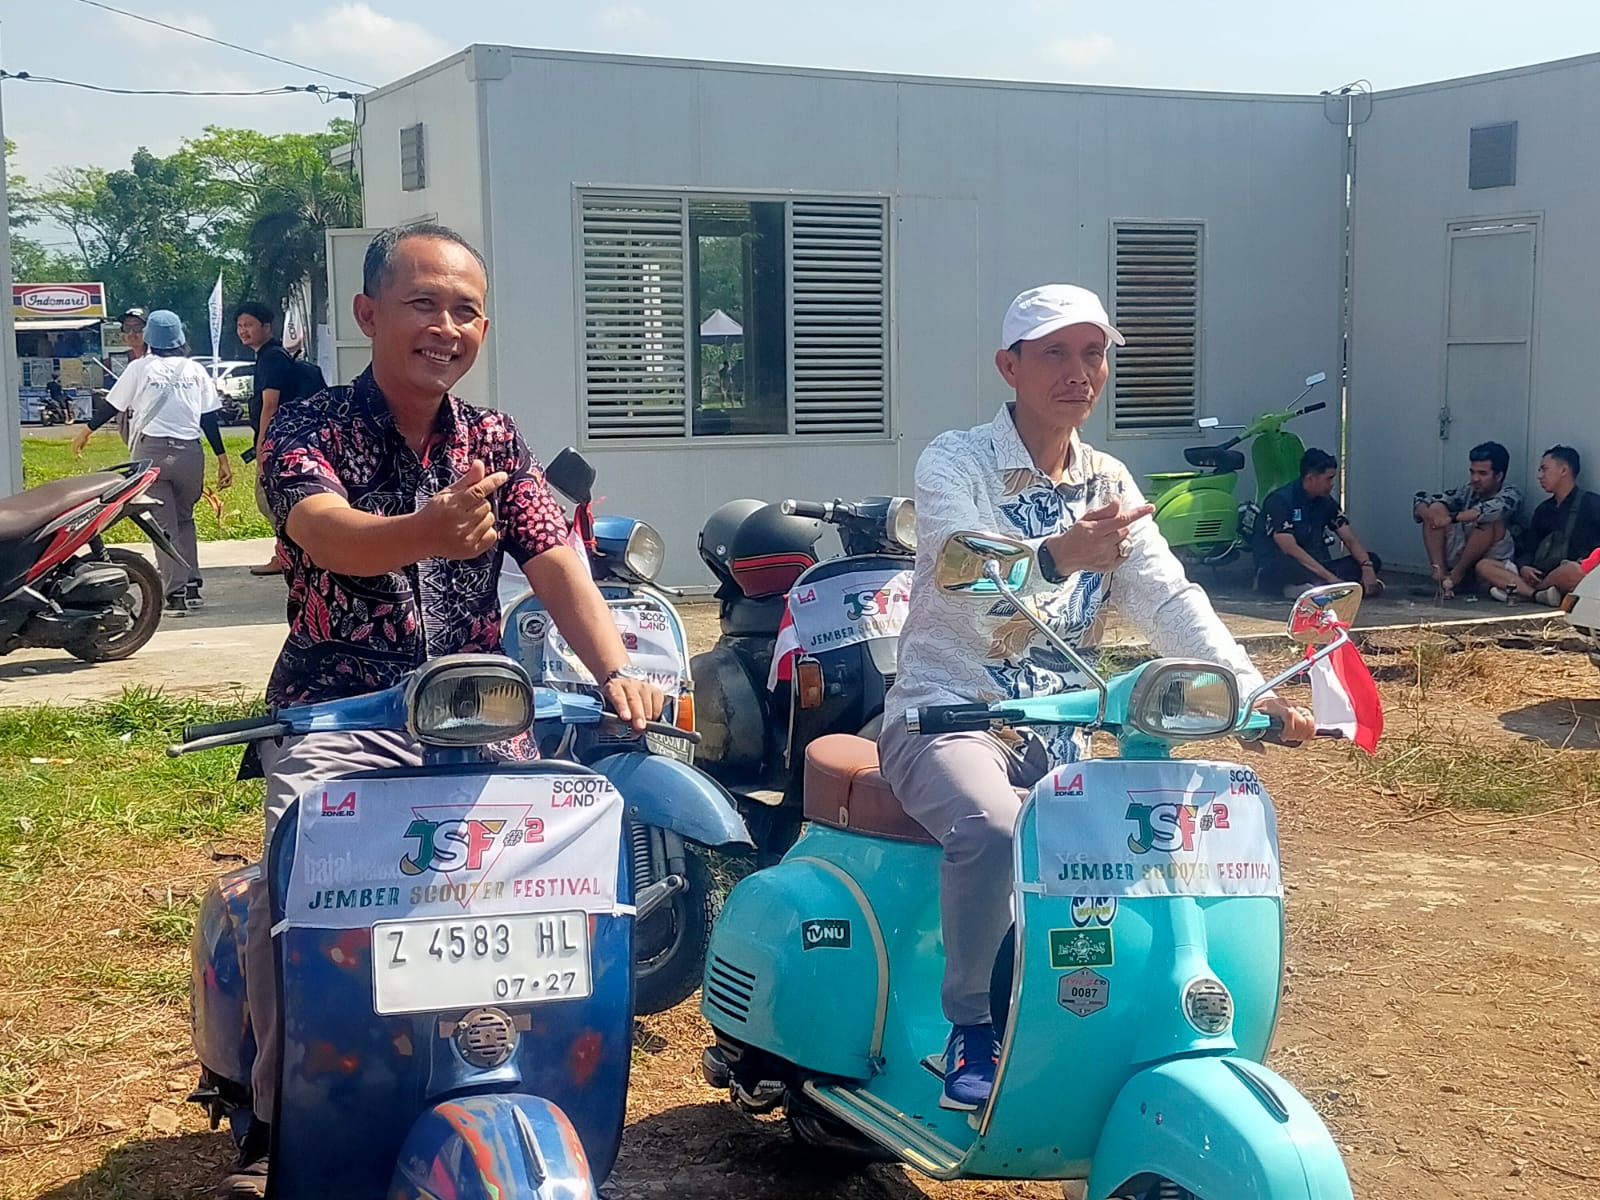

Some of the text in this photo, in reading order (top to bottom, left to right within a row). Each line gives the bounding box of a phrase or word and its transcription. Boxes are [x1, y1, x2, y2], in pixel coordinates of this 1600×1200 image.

[27, 295, 85, 306] Indomaret
[844, 589, 891, 620] JSF
[640, 621, 666, 631] LAND
[811, 627, 854, 646] JEMBER
[552, 780, 615, 793] SCOOTE
[1054, 773, 1083, 791] LA
[1230, 783, 1260, 795] LAND
[322, 792, 356, 811] LA
[551, 794, 595, 808] LAND
[1125, 802, 1199, 854] JSF
[400, 819, 507, 876] JSF
[1058, 863, 1134, 880] JEMBER
[309, 878, 600, 909] JEMBER SCOOTER FESTIVAL
[388, 919, 577, 963] Z 4583 HL
[1071, 987, 1098, 998] 0087
